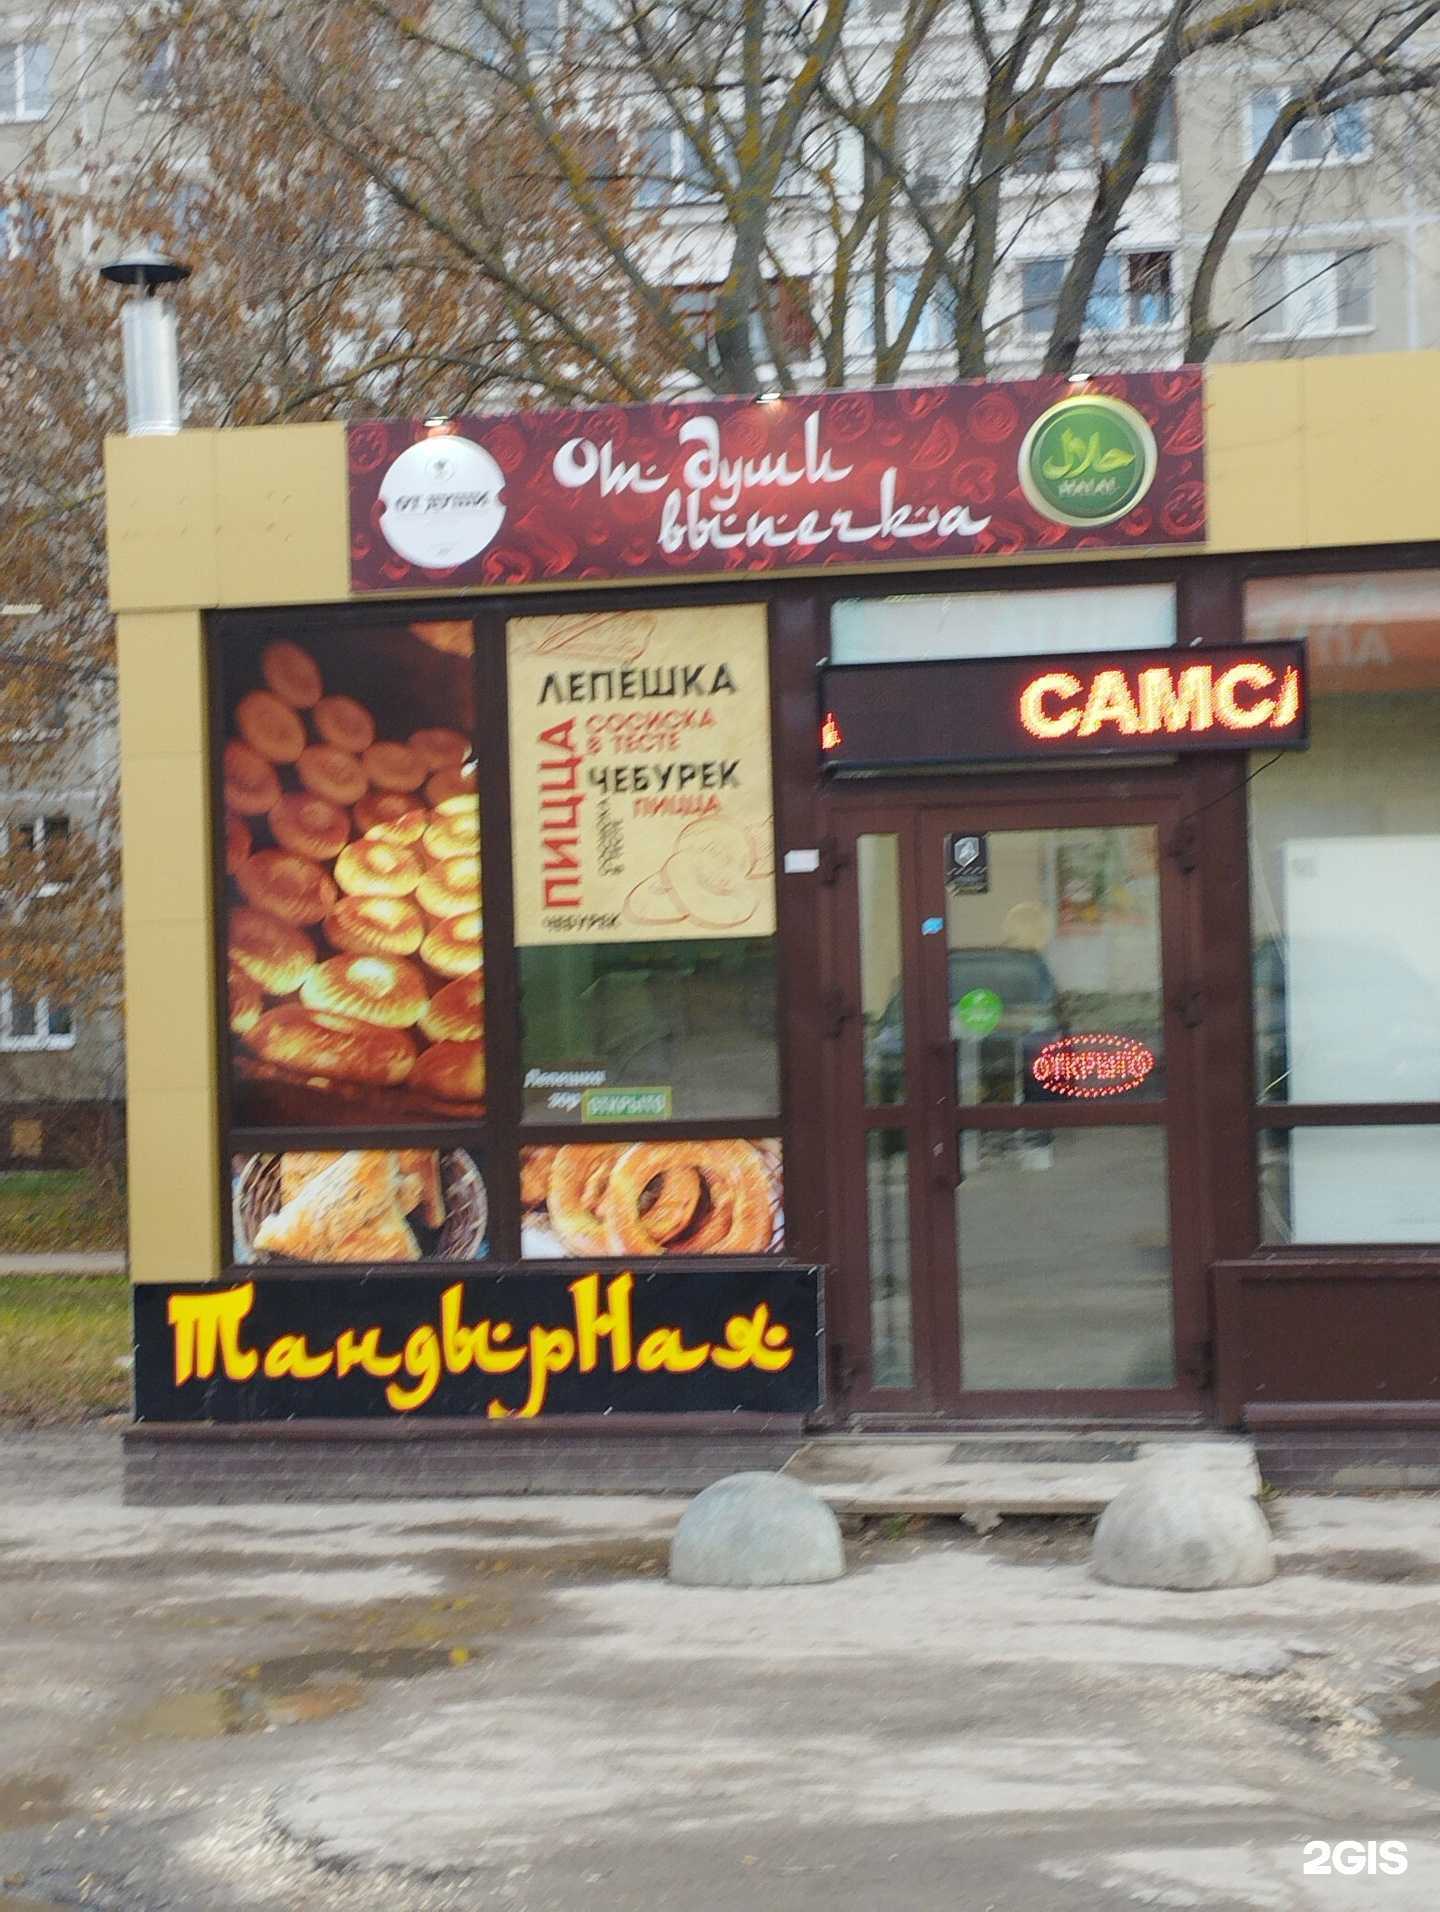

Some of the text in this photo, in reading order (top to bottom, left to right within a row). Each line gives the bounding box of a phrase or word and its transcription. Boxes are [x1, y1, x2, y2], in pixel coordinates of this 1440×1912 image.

[553, 410, 853, 511] От души
[657, 467, 992, 554] выпечка
[537, 664, 738, 705] ЛЕПЕШКА
[585, 709, 716, 733] СОСИСКА
[611, 732, 681, 752] ТЕСТЕ
[587, 761, 740, 794] ЧЕБУРЕК
[538, 716, 585, 908] ПИЦЦА
[632, 795, 720, 817] ПИЦЦА
[1033, 1051, 1155, 1081] ОТКРЫТО
